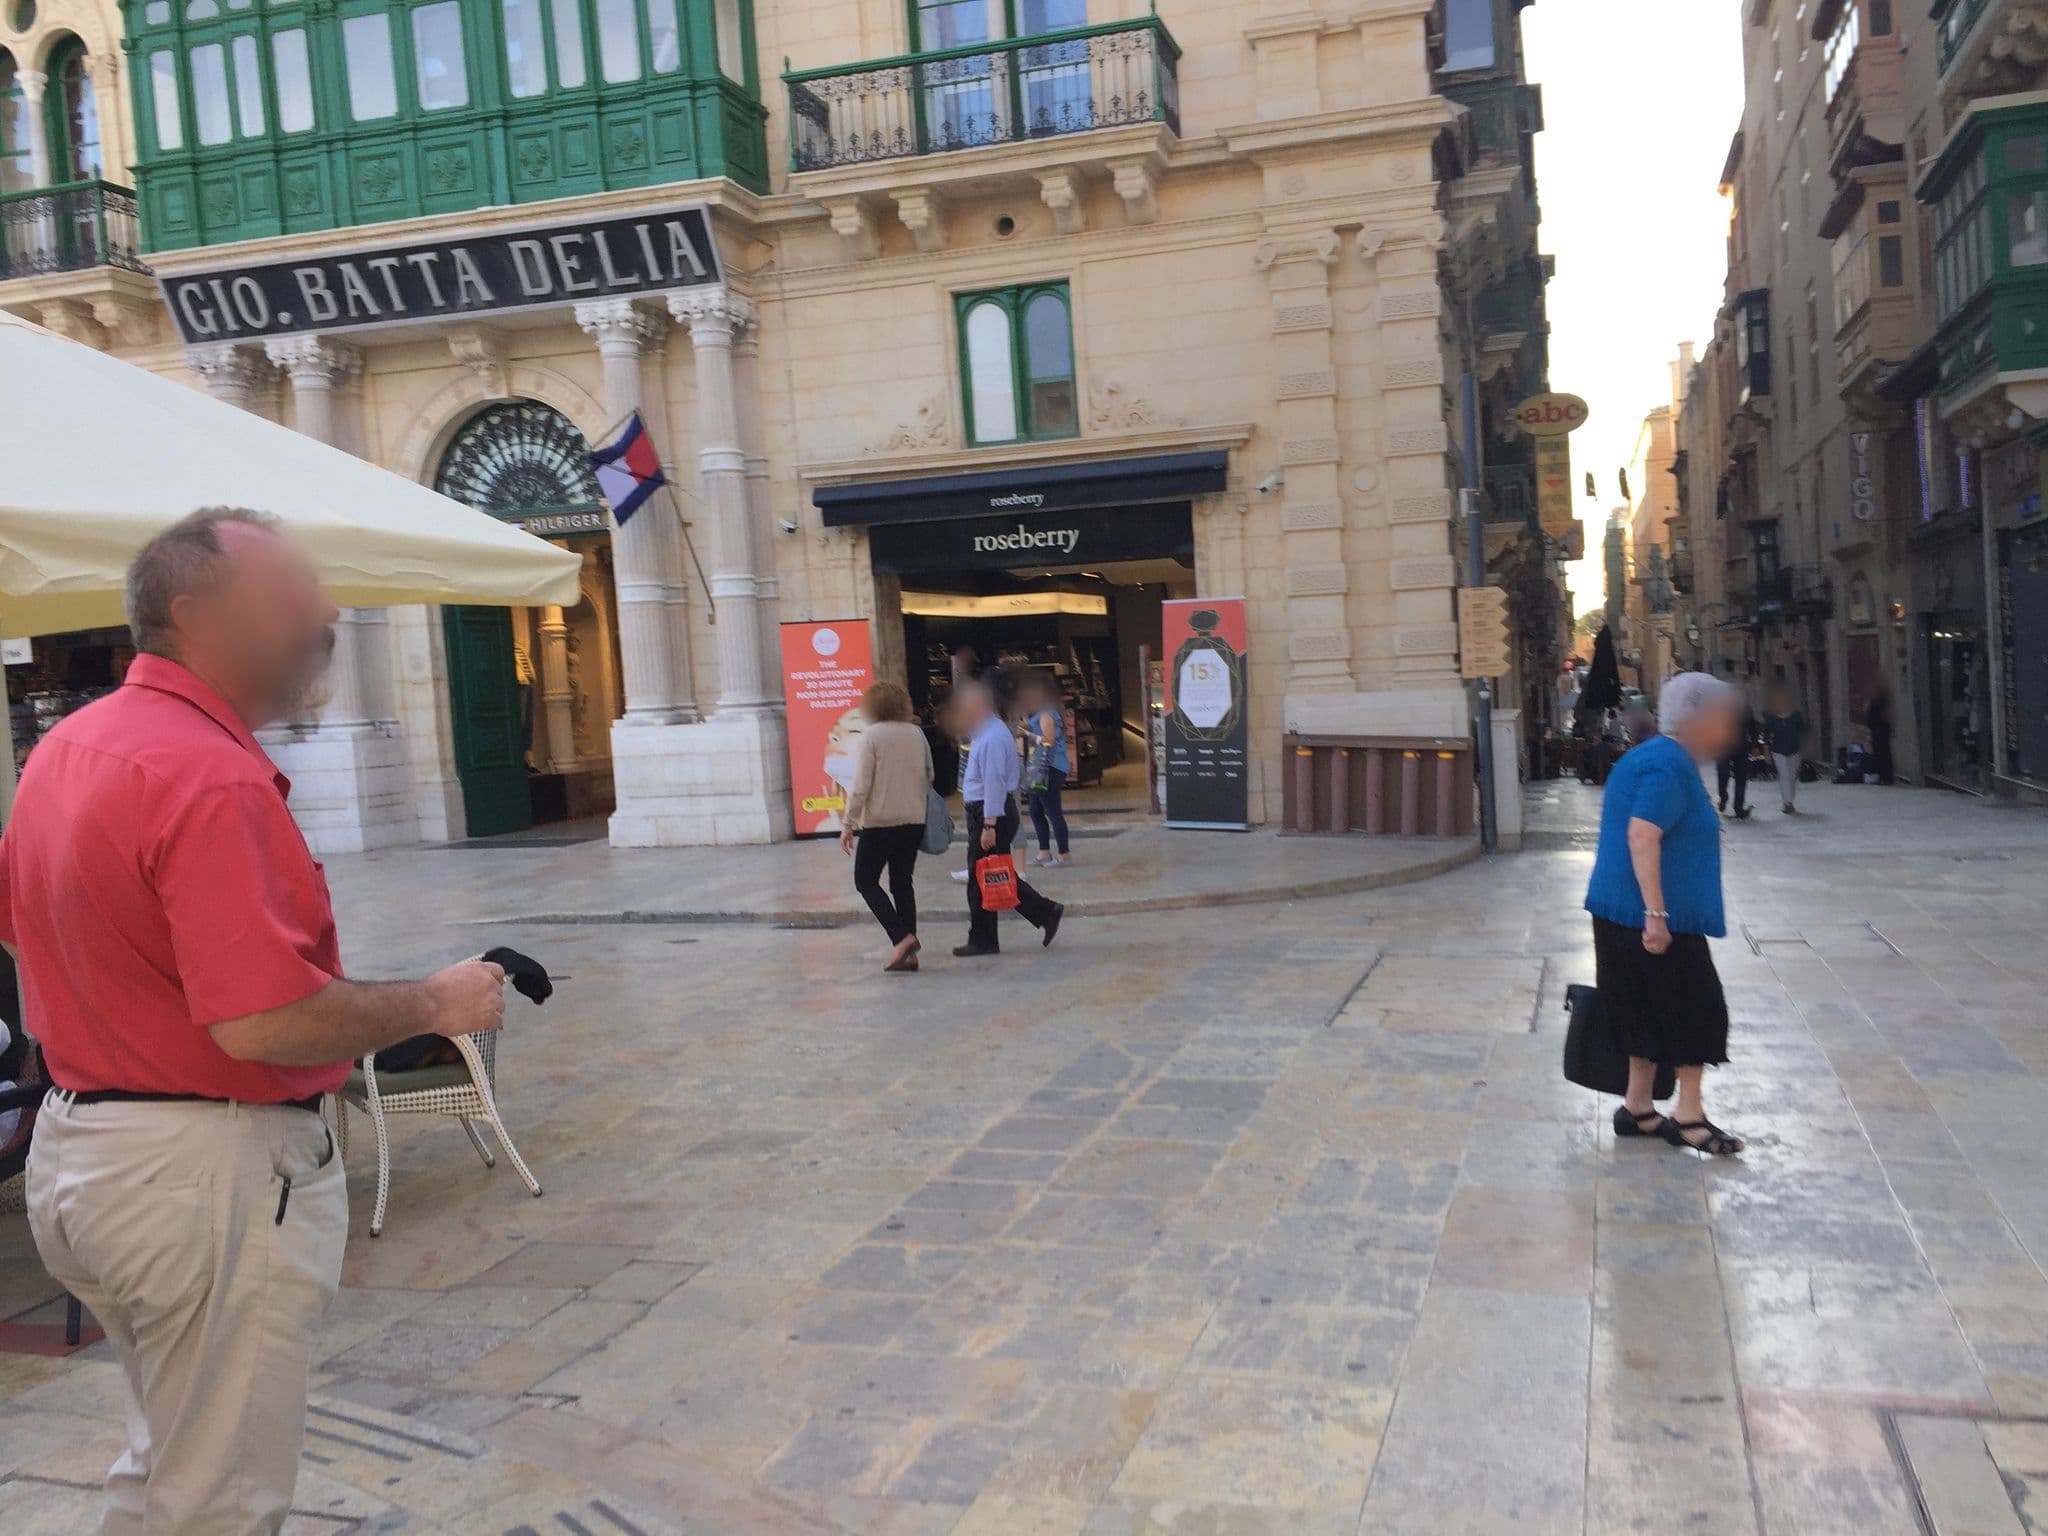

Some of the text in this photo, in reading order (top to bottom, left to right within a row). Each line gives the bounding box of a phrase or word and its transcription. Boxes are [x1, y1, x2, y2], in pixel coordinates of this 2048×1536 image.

[177, 220, 708, 335] GIO. BATTA DELIA
[1524, 401, 1580, 425] abc
[990, 493, 1044, 507] roseberry
[528, 514, 602, 530] HILFIGER
[973, 524, 1080, 553] roseberry
[818, 660, 838, 668] THE
